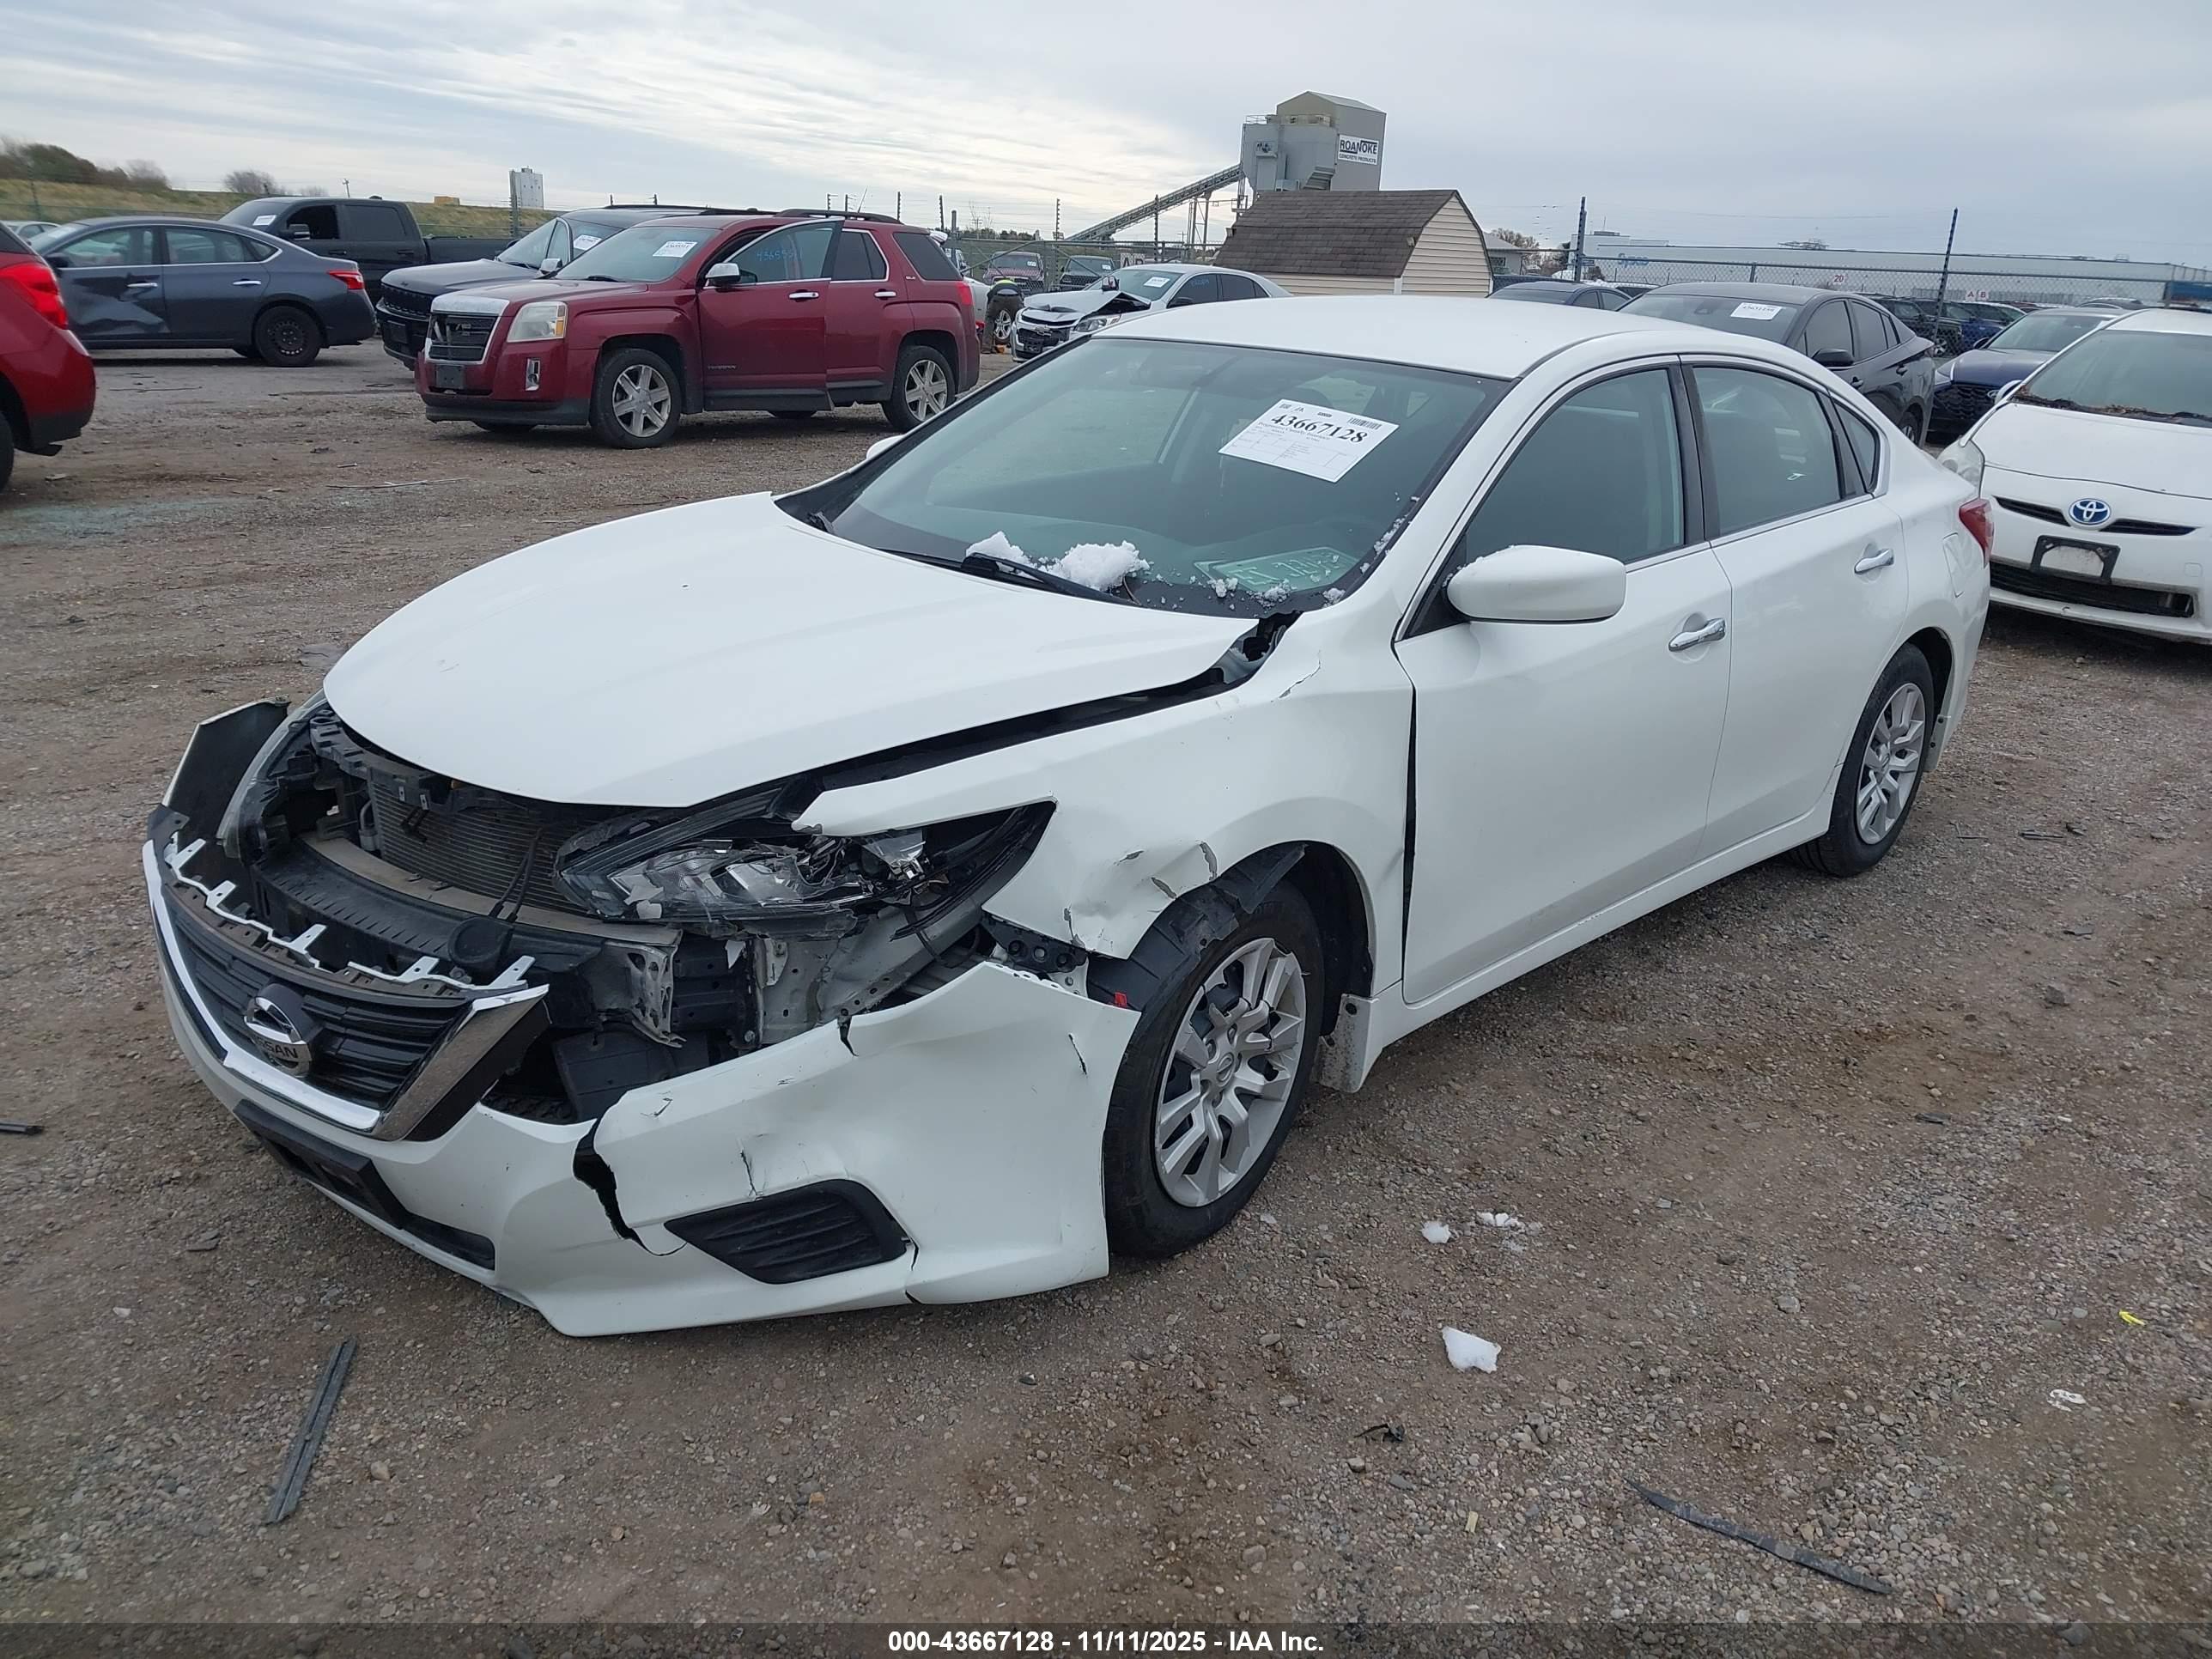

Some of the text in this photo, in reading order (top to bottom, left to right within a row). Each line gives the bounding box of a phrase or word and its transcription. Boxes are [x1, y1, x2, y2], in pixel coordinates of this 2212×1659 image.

[1340, 139, 1377, 155] ROANOKE
[1833, 274, 1844, 283] 20
[1271, 414, 1368, 443] 43667128
